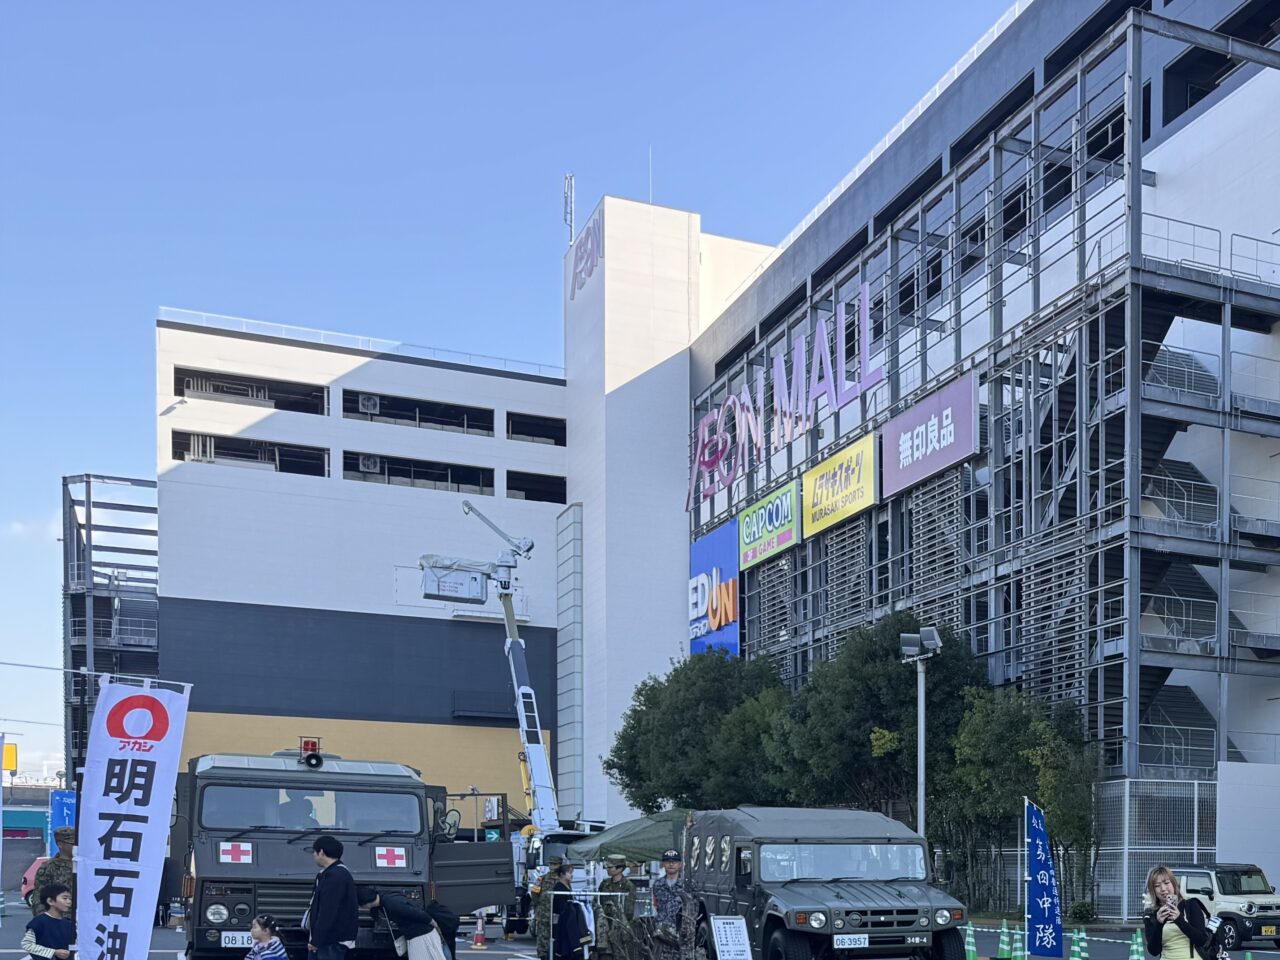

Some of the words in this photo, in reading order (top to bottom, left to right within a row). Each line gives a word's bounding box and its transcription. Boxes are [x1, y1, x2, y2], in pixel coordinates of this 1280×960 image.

[773, 281, 886, 451] MALL
[899, 407, 955, 469] 無印良品
[811, 501, 841, 524] MURASAKI
[841, 487, 865, 511] SPORTS
[812, 450, 864, 508] ムラサキスポーツ
[743, 491, 793, 545] CAPCOM
[758, 536, 776, 556] GAME
[118, 740, 155, 752] アカシ
